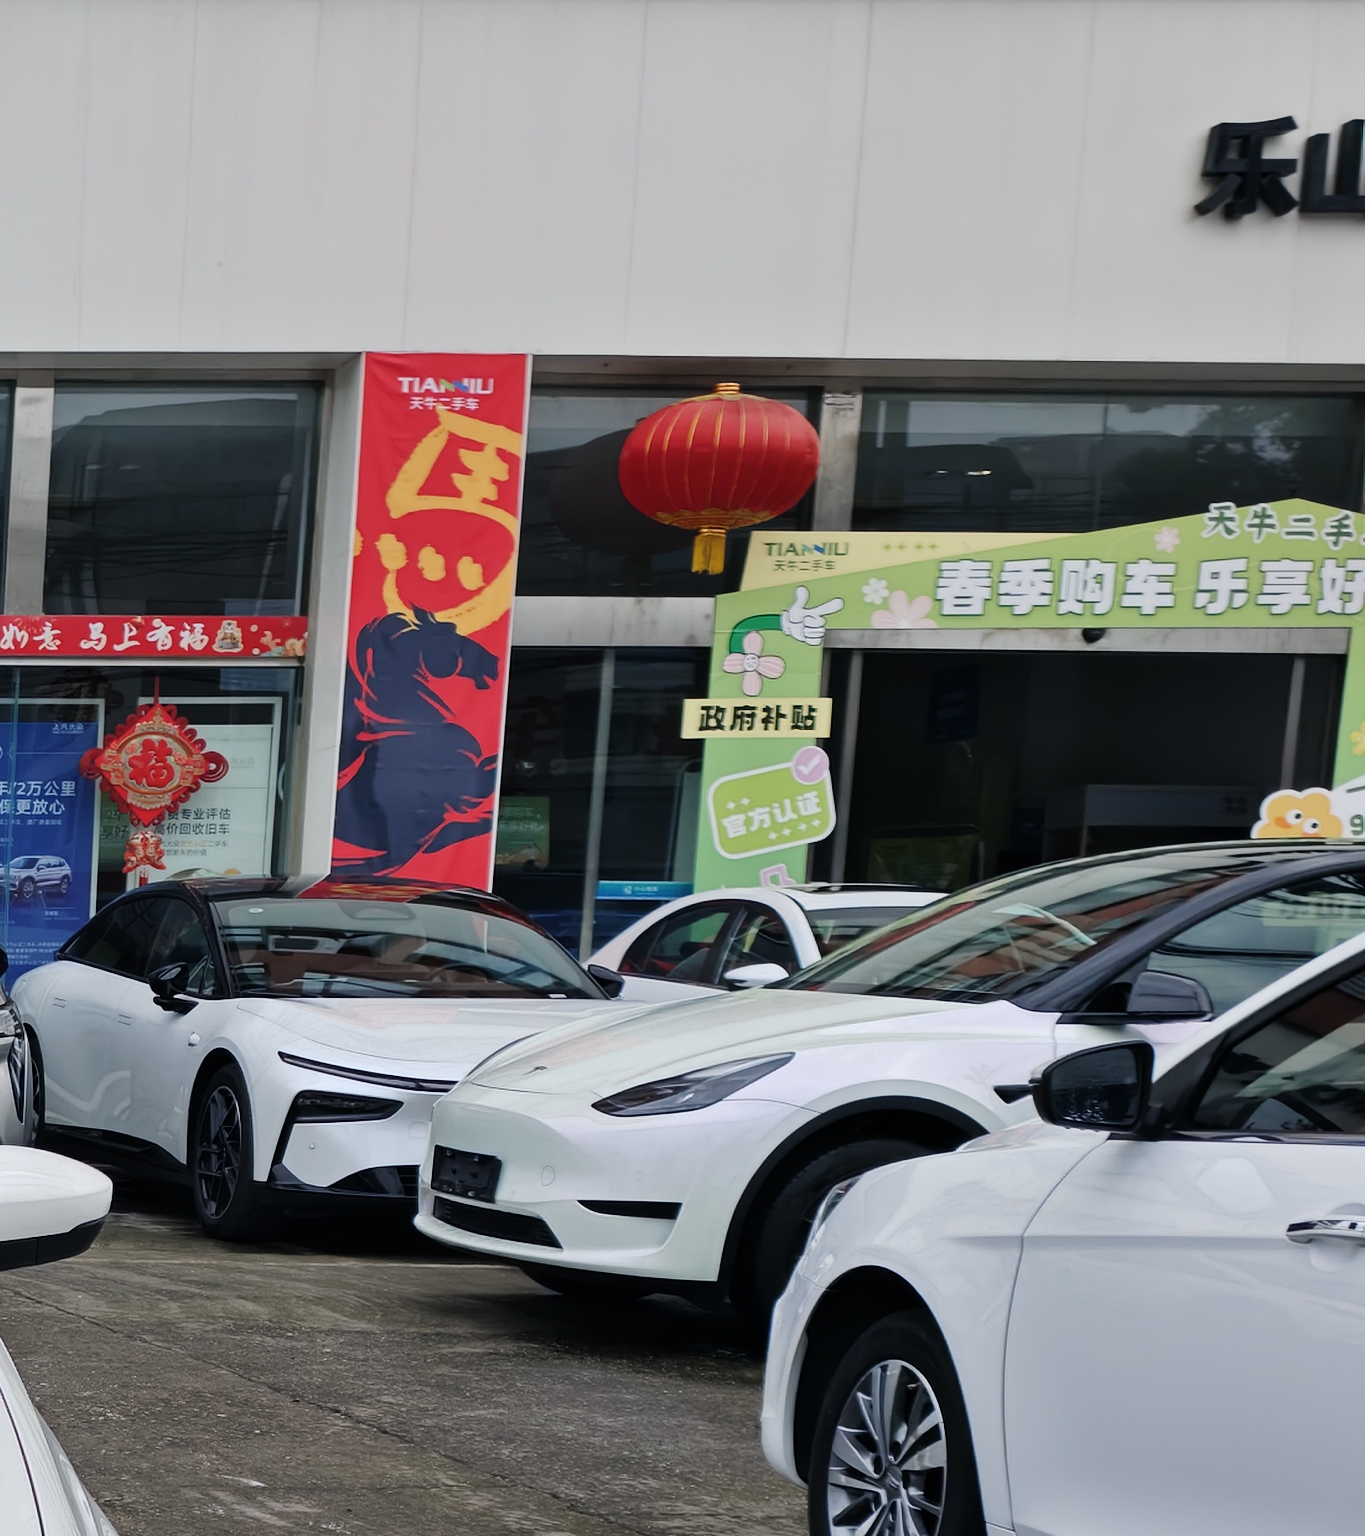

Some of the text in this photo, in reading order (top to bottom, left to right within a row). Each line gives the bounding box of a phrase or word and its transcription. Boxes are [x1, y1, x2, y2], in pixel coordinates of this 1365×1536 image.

[409, 397, 480, 411] 天牛二手车
[1201, 502, 1365, 550] 天牛二手
[774, 559, 836, 572] 天牛二手车
[936, 558, 1176, 618] 春季购车
[79, 619, 209, 652] 马上有福
[698, 704, 819, 732] 政府补贴
[128, 738, 175, 789] 福
[722, 790, 822, 839] 官方认证
